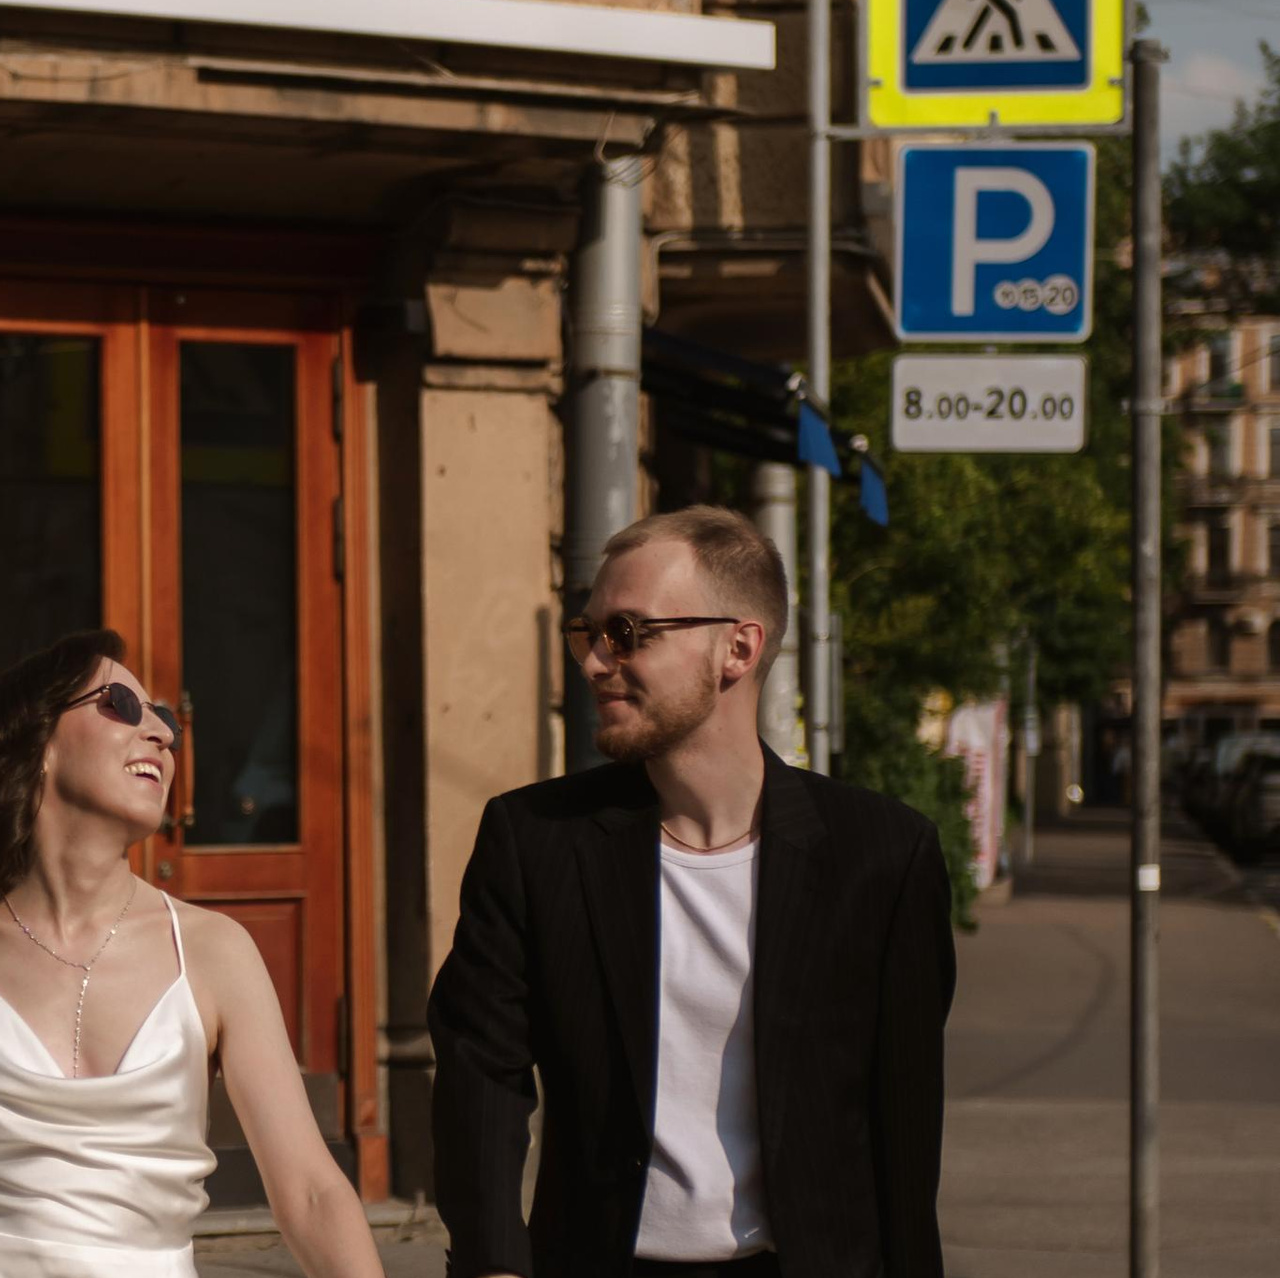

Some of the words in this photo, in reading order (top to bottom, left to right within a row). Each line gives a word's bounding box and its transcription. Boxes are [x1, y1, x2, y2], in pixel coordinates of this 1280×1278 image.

[951, 165, 1056, 317] P
[1046, 286, 1075, 307] 20
[904, 387, 1074, 419] 8.00-20.00
